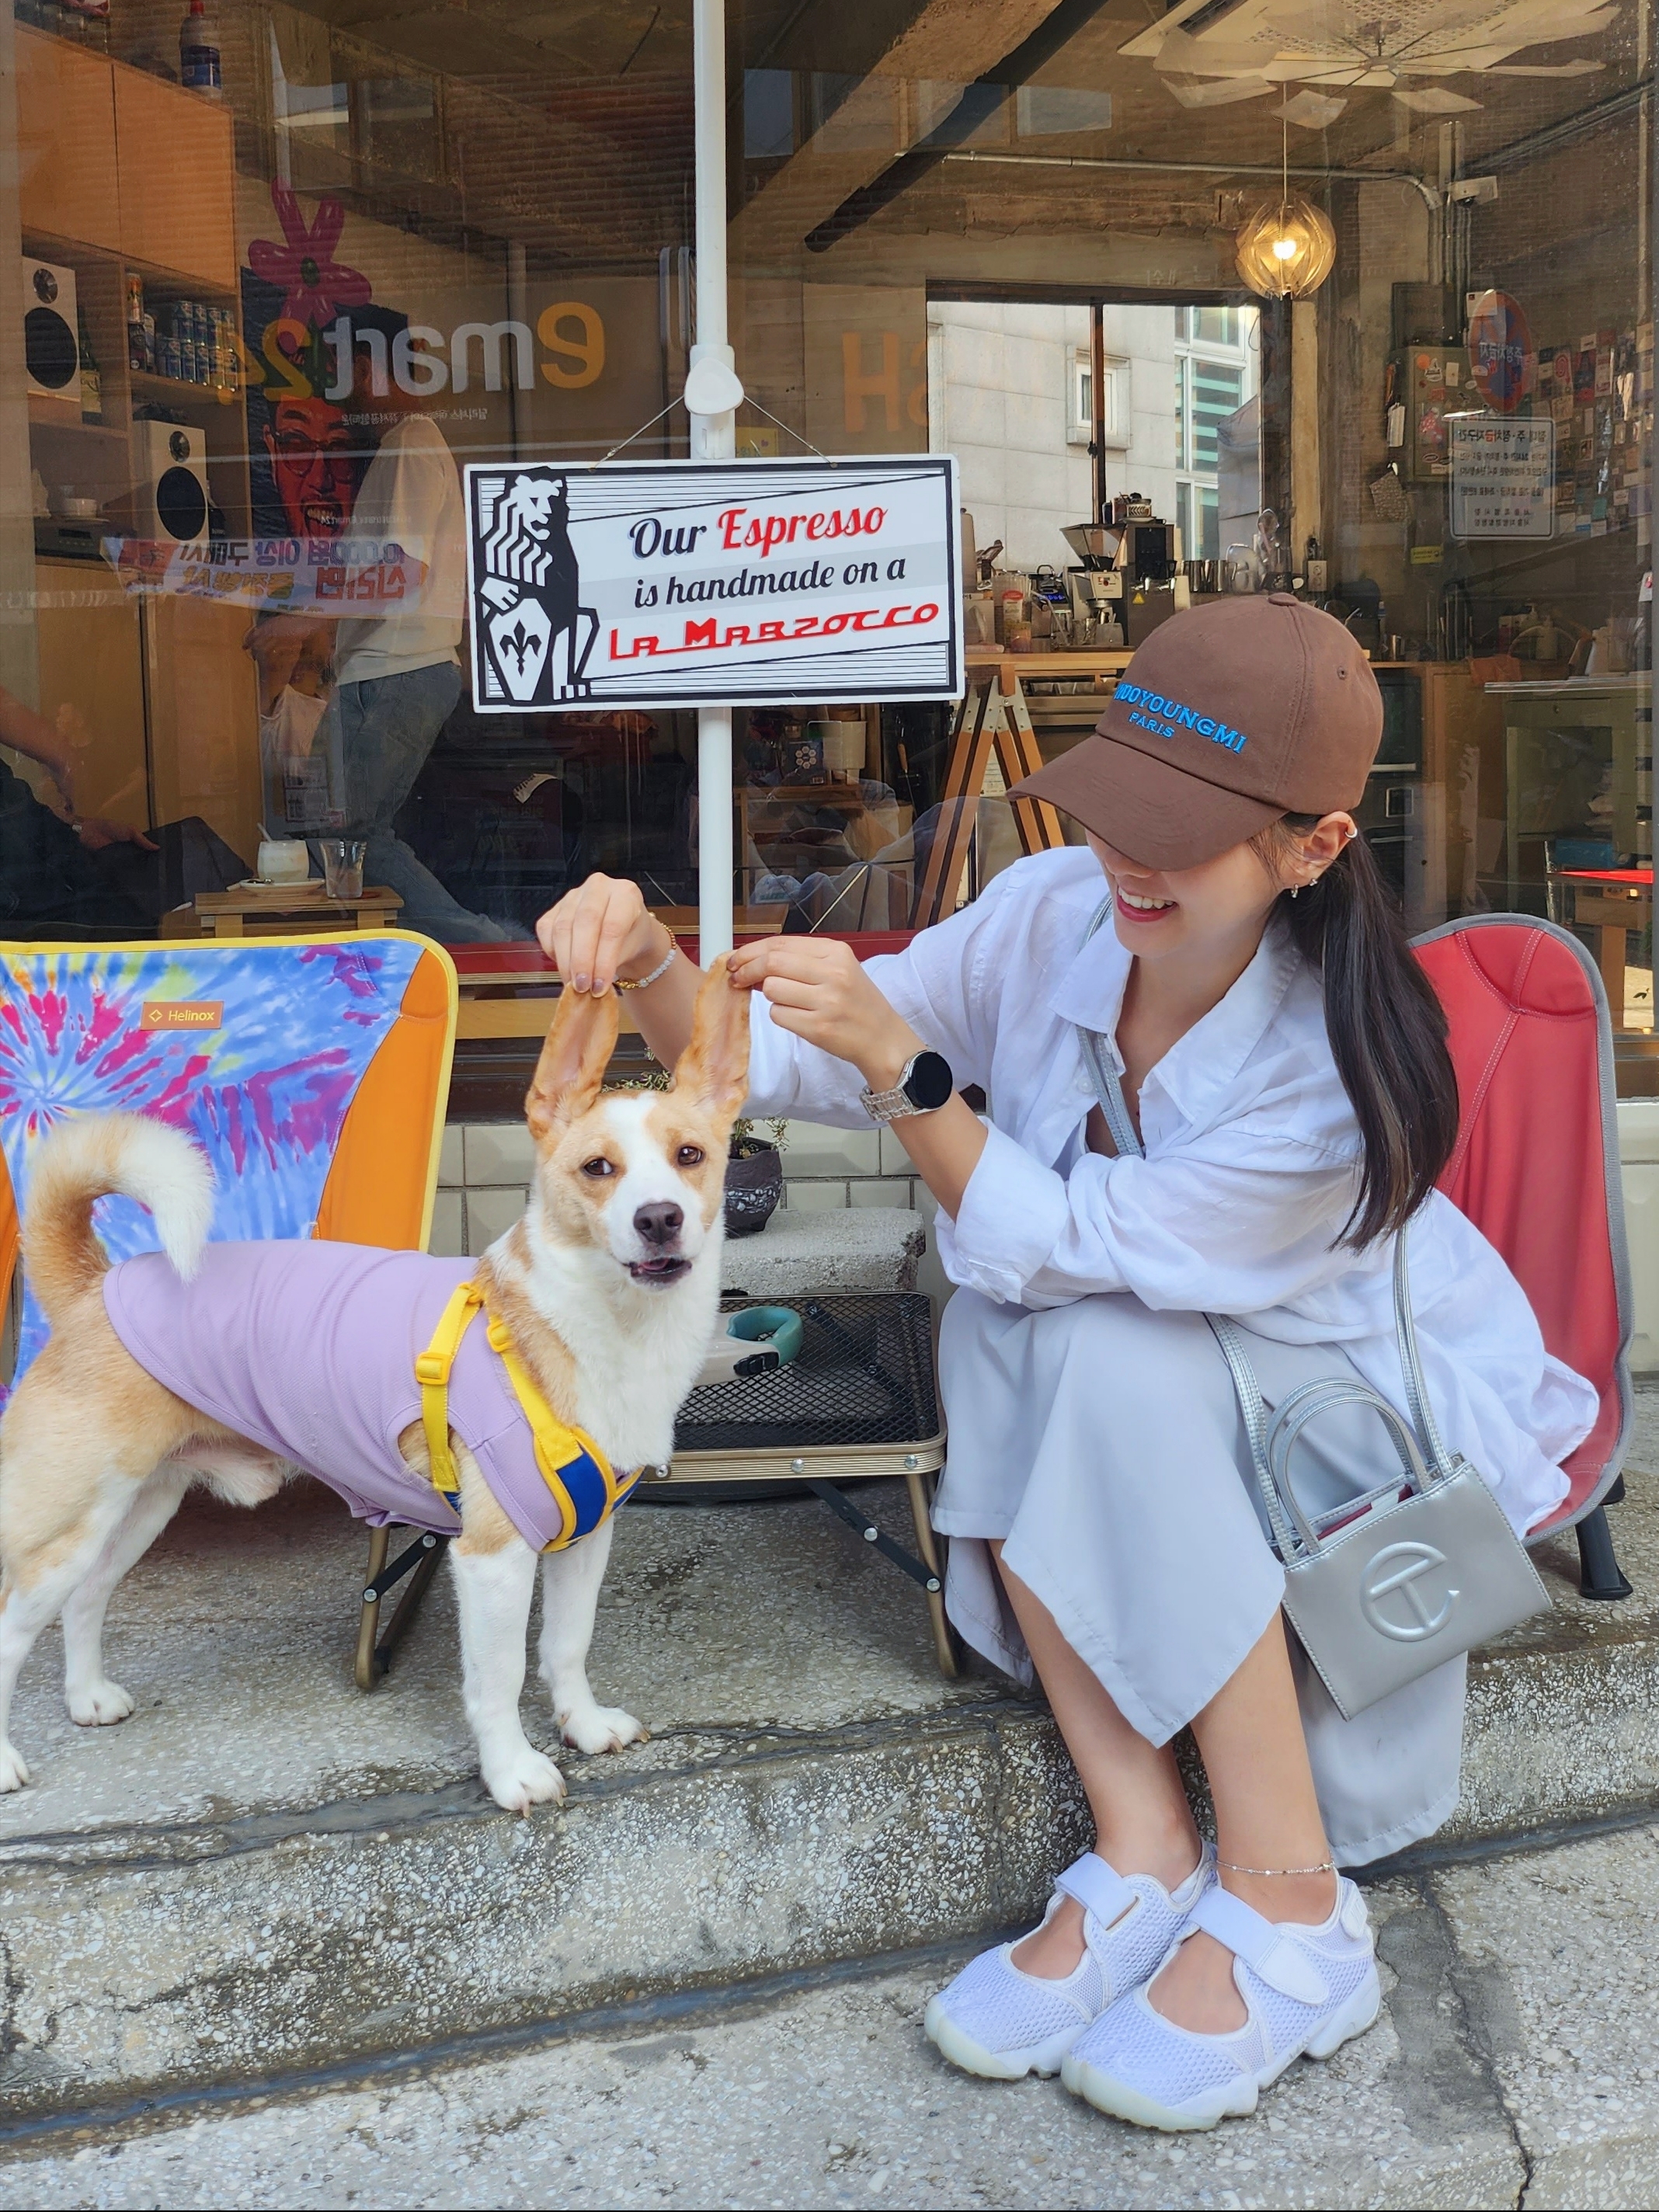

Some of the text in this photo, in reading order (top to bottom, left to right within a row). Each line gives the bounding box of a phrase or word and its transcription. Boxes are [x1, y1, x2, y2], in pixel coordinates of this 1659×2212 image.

[628, 506, 888, 559] Our Espresso
[634, 557, 907, 609] is handmade on a
[1128, 711, 1175, 738] PARIS
[168, 1009, 215, 1021] Helinox
